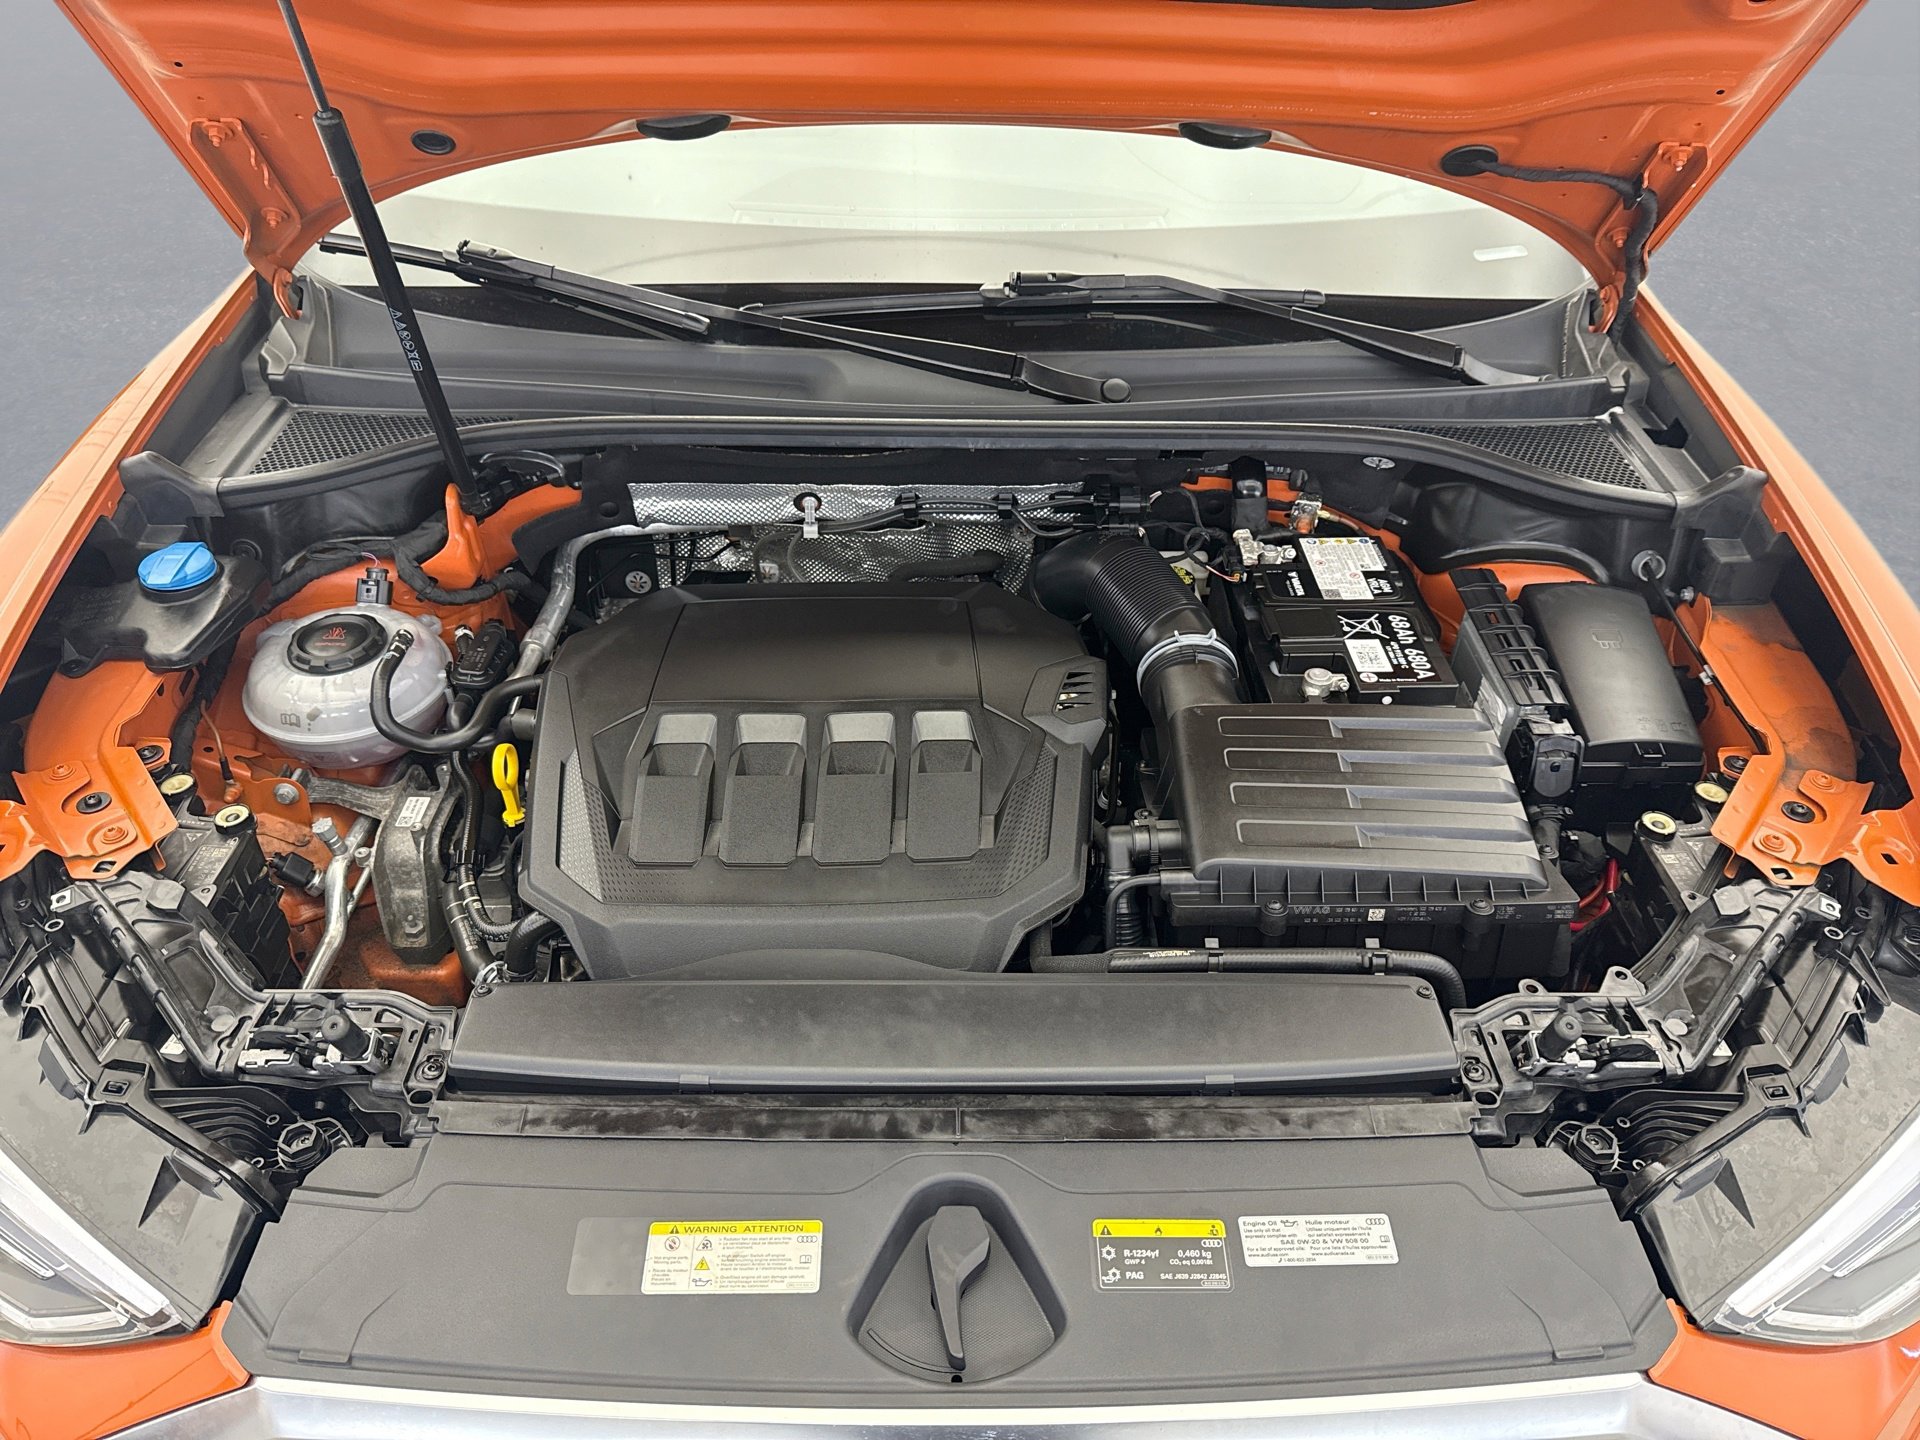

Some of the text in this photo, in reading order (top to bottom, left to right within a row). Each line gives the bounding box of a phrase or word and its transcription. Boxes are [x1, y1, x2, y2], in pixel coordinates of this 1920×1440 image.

[1367, 578, 1382, 594] VRLA
[1377, 579, 1393, 592] AGM
[1387, 614, 1417, 645] 68Ah
[1404, 648, 1436, 679] 680A
[684, 1225, 804, 1234] WARNING ATTENTION
[1123, 1249, 1160, 1259] R-1234yf
[1177, 1250, 1212, 1259] 0,460 kg
[1125, 1271, 1145, 1280] PAG
